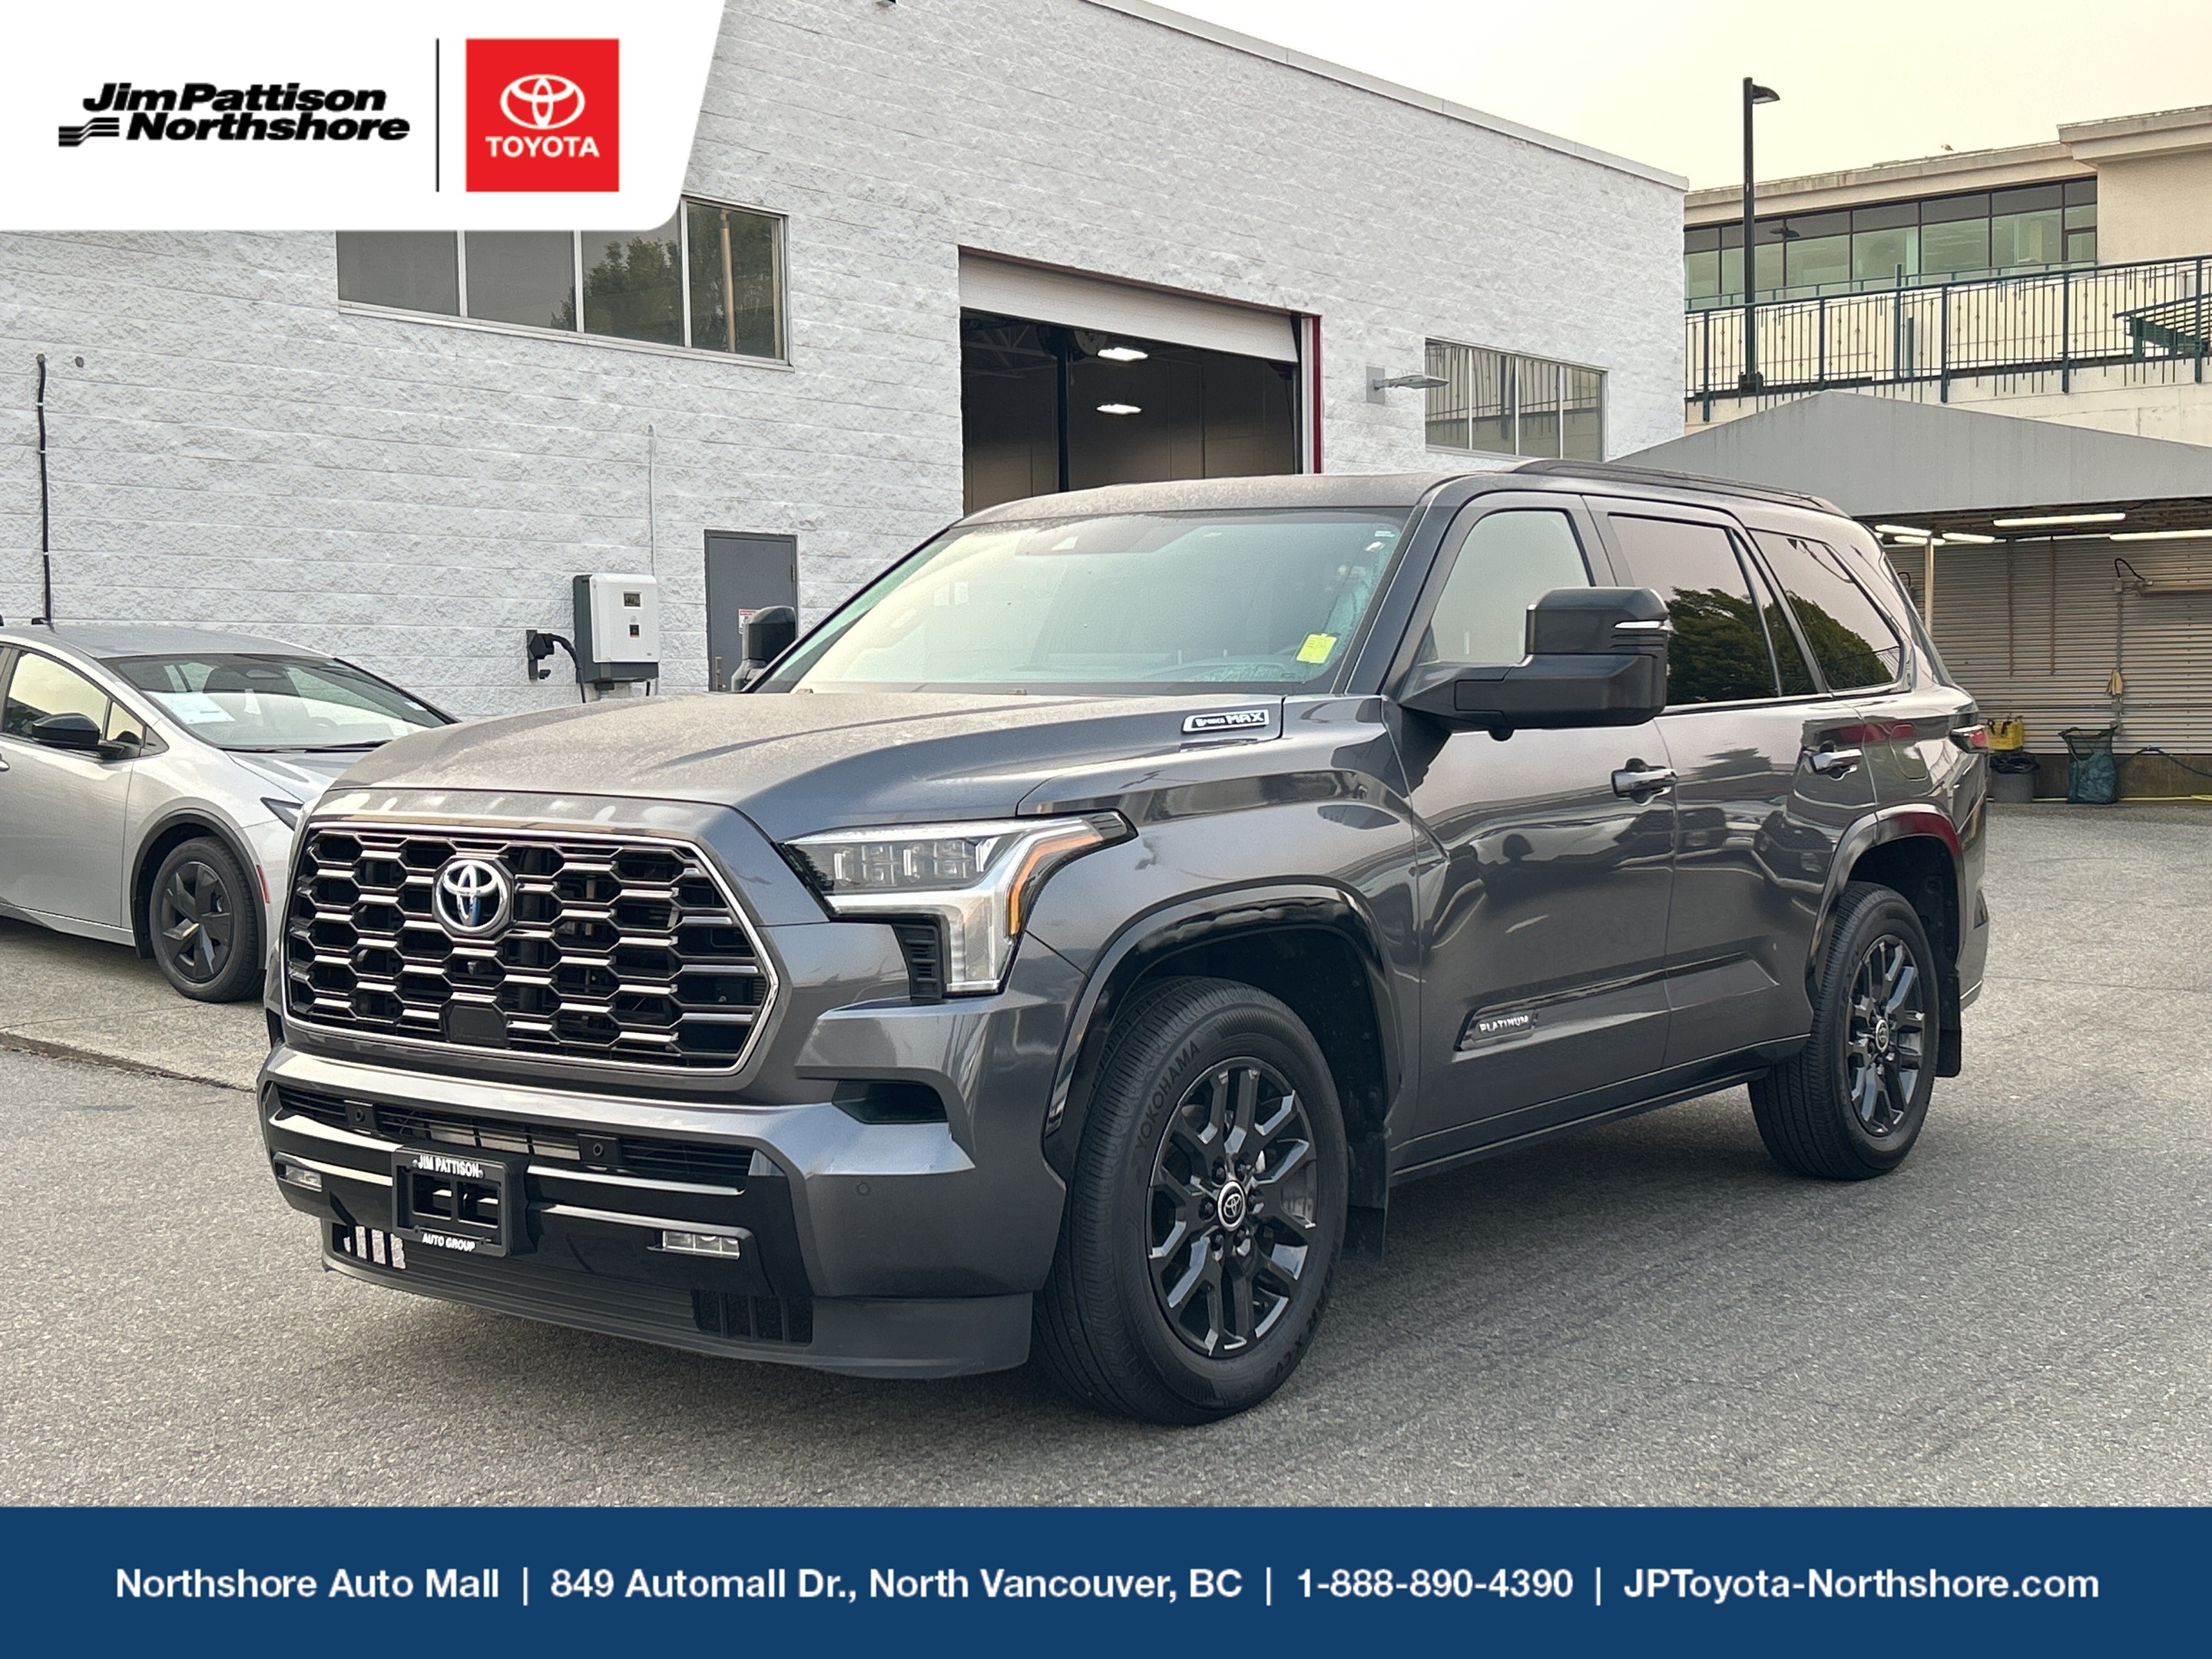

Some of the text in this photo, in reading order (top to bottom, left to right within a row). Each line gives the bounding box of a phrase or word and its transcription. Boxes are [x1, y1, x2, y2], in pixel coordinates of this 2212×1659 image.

[1225, 712, 1264, 724] MAX
[1479, 1015, 1529, 1032] PLATINUM
[1134, 1039, 1200, 1150] YOKOHAMA
[418, 1154, 481, 1178] JIM PATTISON
[422, 1233, 475, 1252] AUTO GROUP
